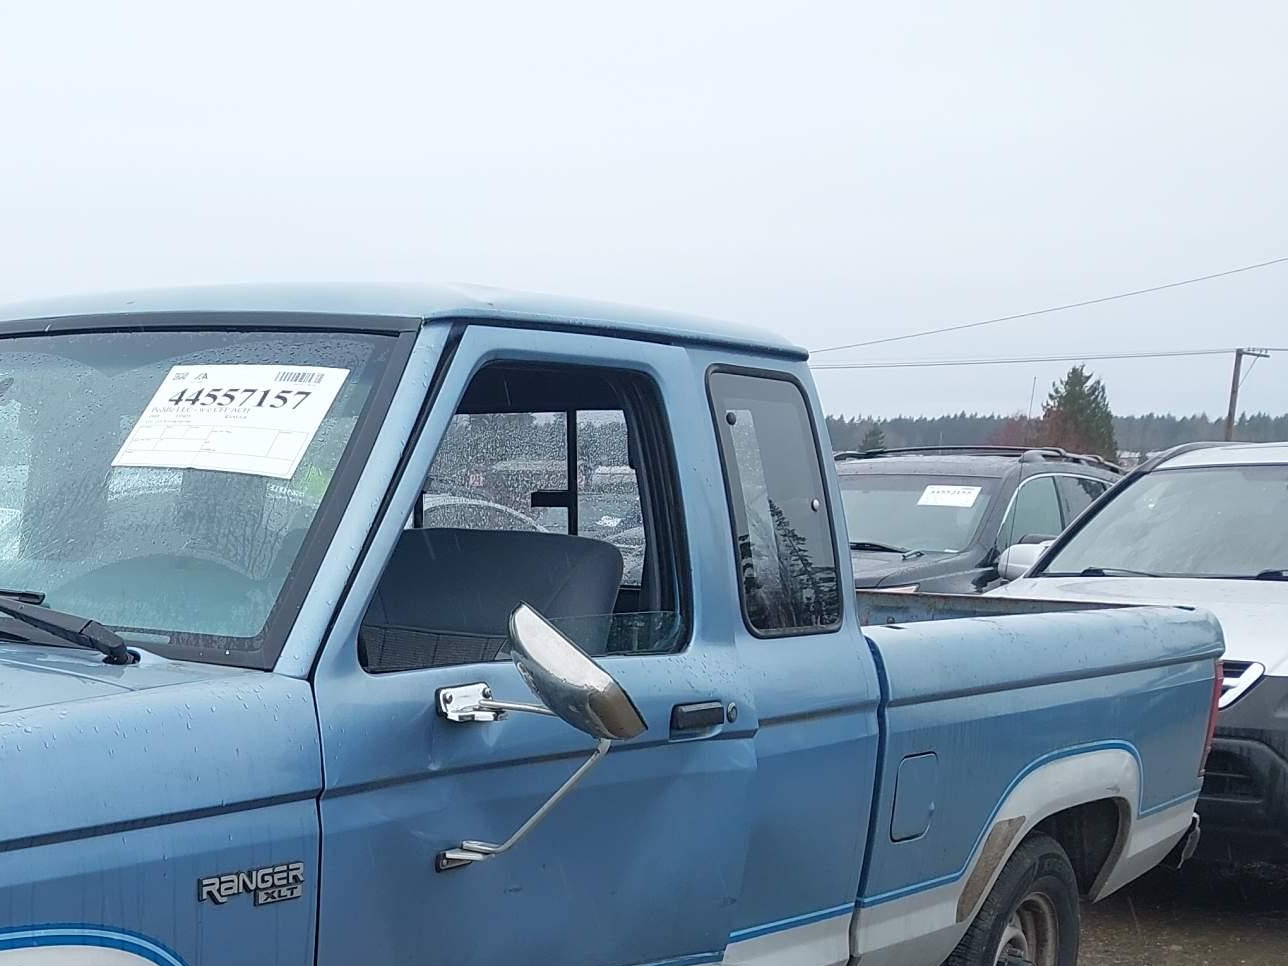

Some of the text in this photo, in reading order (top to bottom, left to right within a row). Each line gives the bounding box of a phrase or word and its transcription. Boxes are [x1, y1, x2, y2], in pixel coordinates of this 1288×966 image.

[168, 388, 312, 410] 44557157
[198, 861, 305, 904] RANGER
[260, 884, 300, 904] XLT
